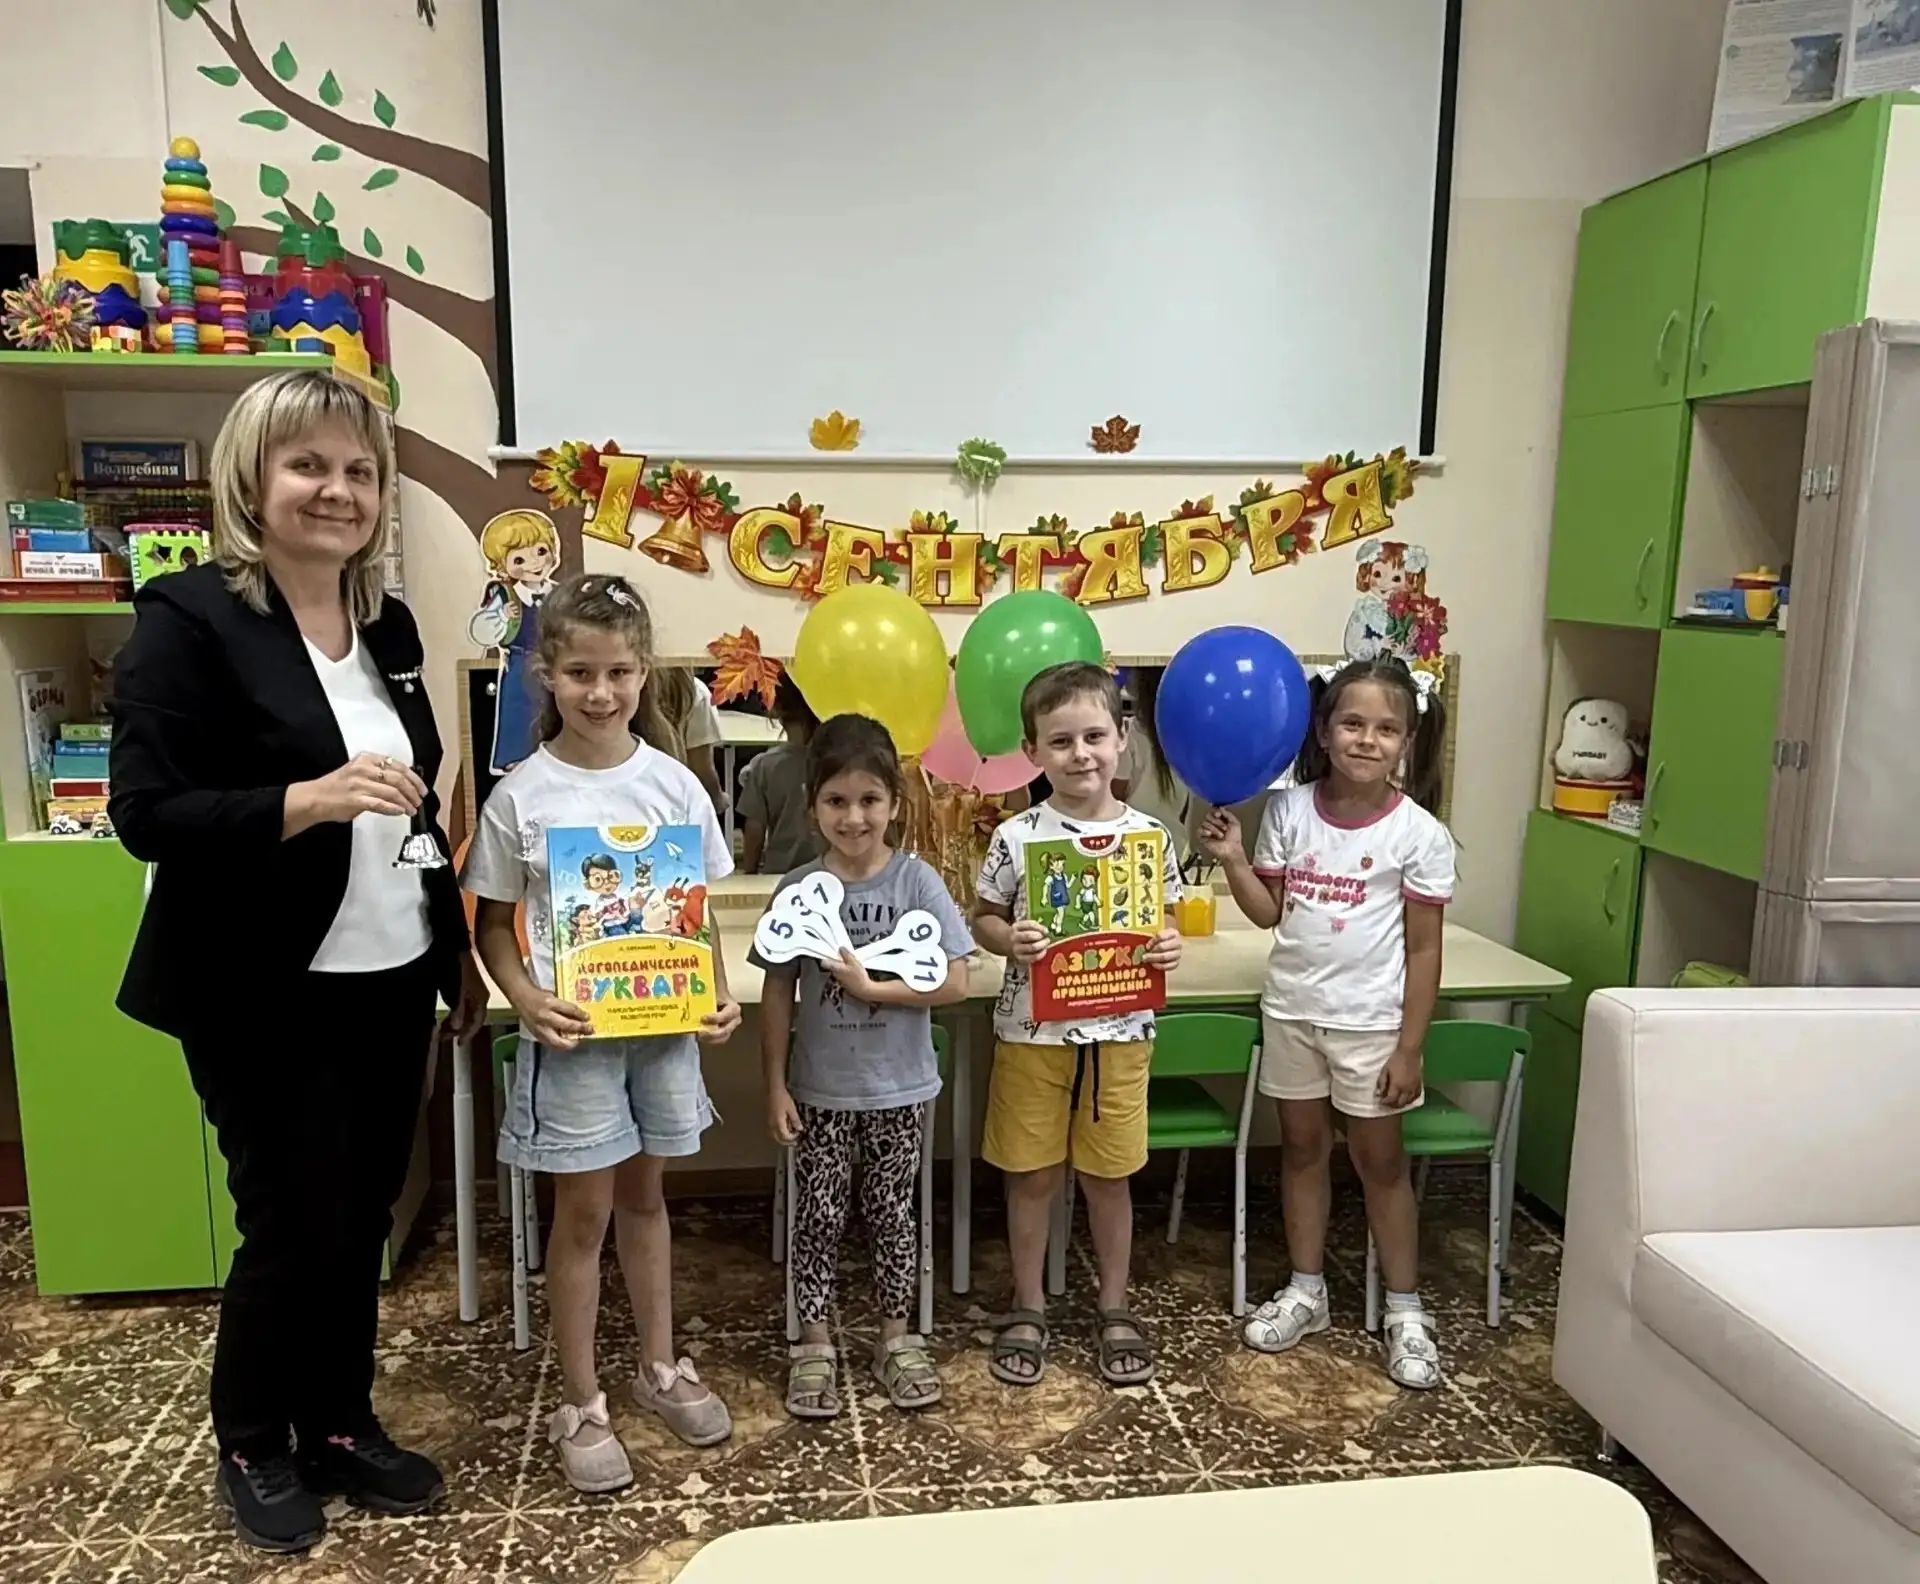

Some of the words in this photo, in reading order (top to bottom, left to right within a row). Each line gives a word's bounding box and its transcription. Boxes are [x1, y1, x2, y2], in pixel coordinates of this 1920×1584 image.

[93, 461, 178, 476] Волшебная
[583, 454, 647, 548] 1
[729, 459, 1393, 606] СЕНТЯБРЯ
[813, 883, 829, 904] 7
[769, 919, 794, 939] 5
[908, 923, 933, 942] 9
[578, 954, 699, 974] ЛОГОПЕДИЧЕСКИЙ
[914, 956, 938, 983] 11
[1057, 967, 1147, 987] ПРАВИЛЬНОГО
[575, 972, 706, 1003] БУКВАРЬ
[1052, 978, 1152, 1000] ПРОИЗНОШЕНИЯ
